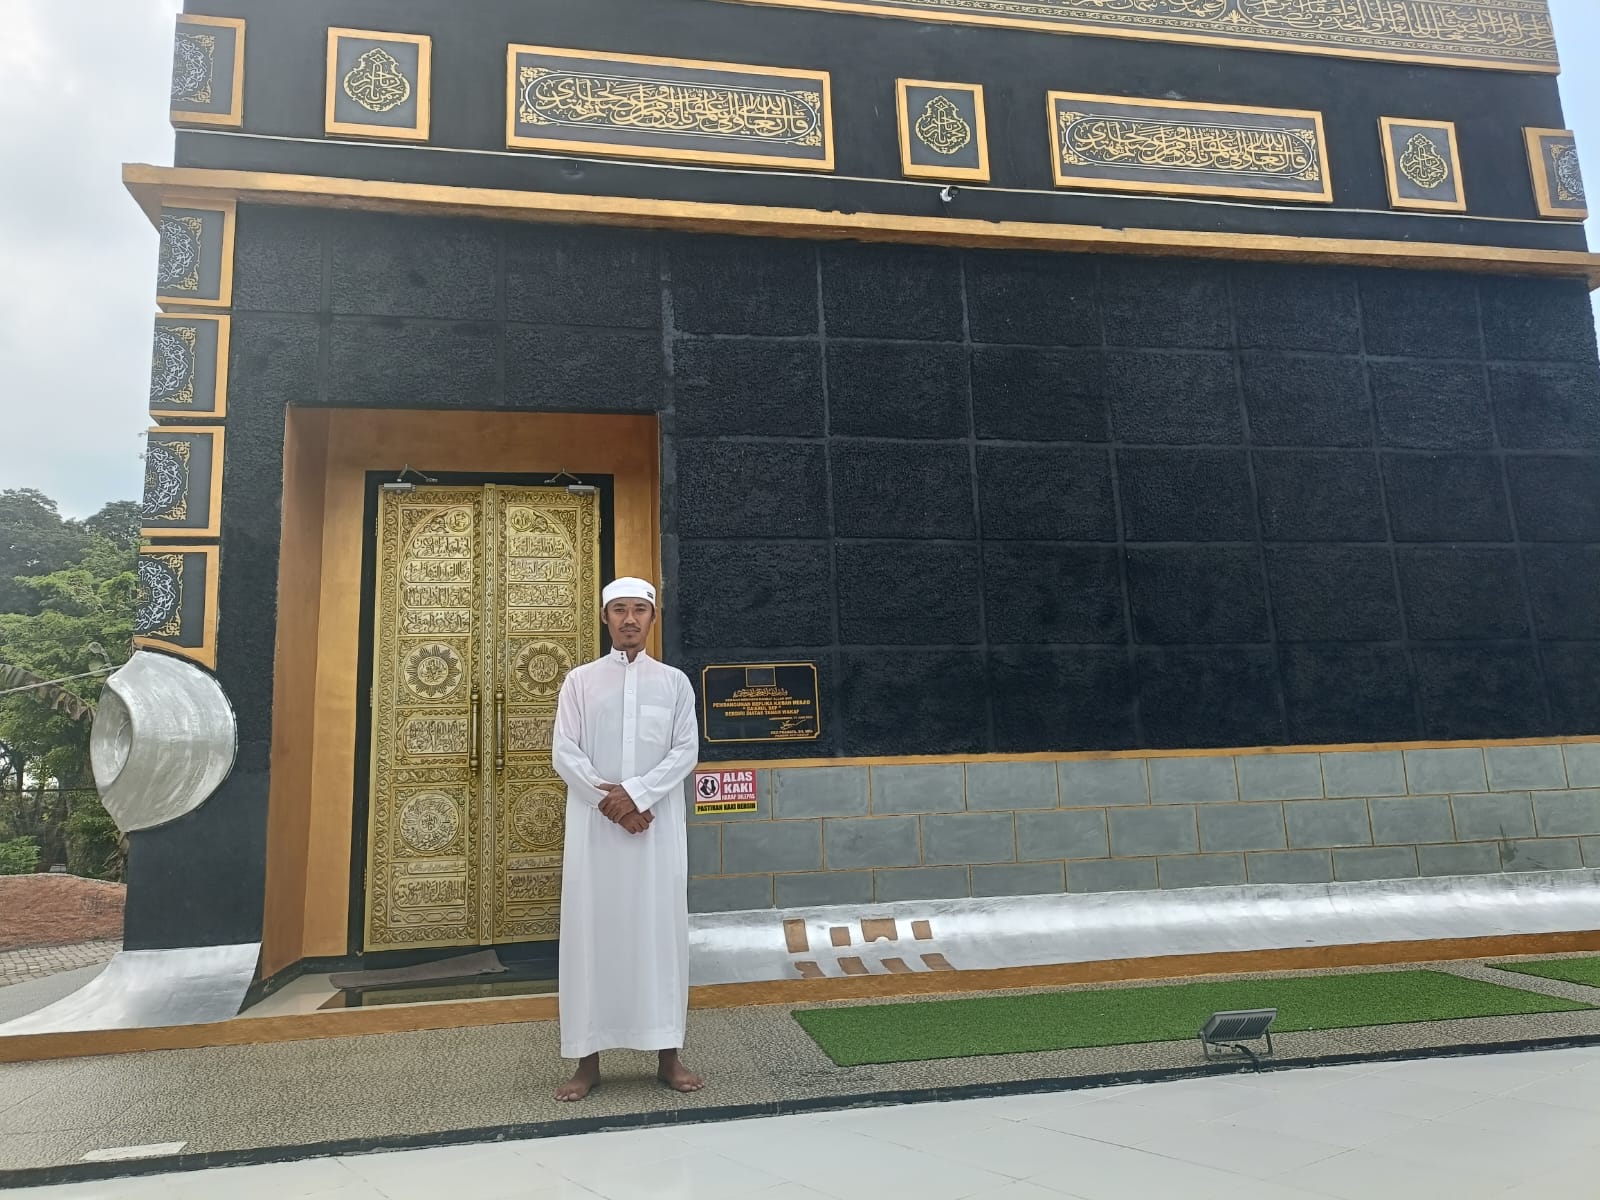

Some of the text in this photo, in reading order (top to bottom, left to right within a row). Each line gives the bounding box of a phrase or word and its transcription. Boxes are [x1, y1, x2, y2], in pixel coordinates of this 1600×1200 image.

[723, 771, 753, 783] ALAS
[724, 782, 753, 794] KAKI
[697, 804, 723, 812] PASTIKAN
[737, 802, 756, 810] BERSIH
